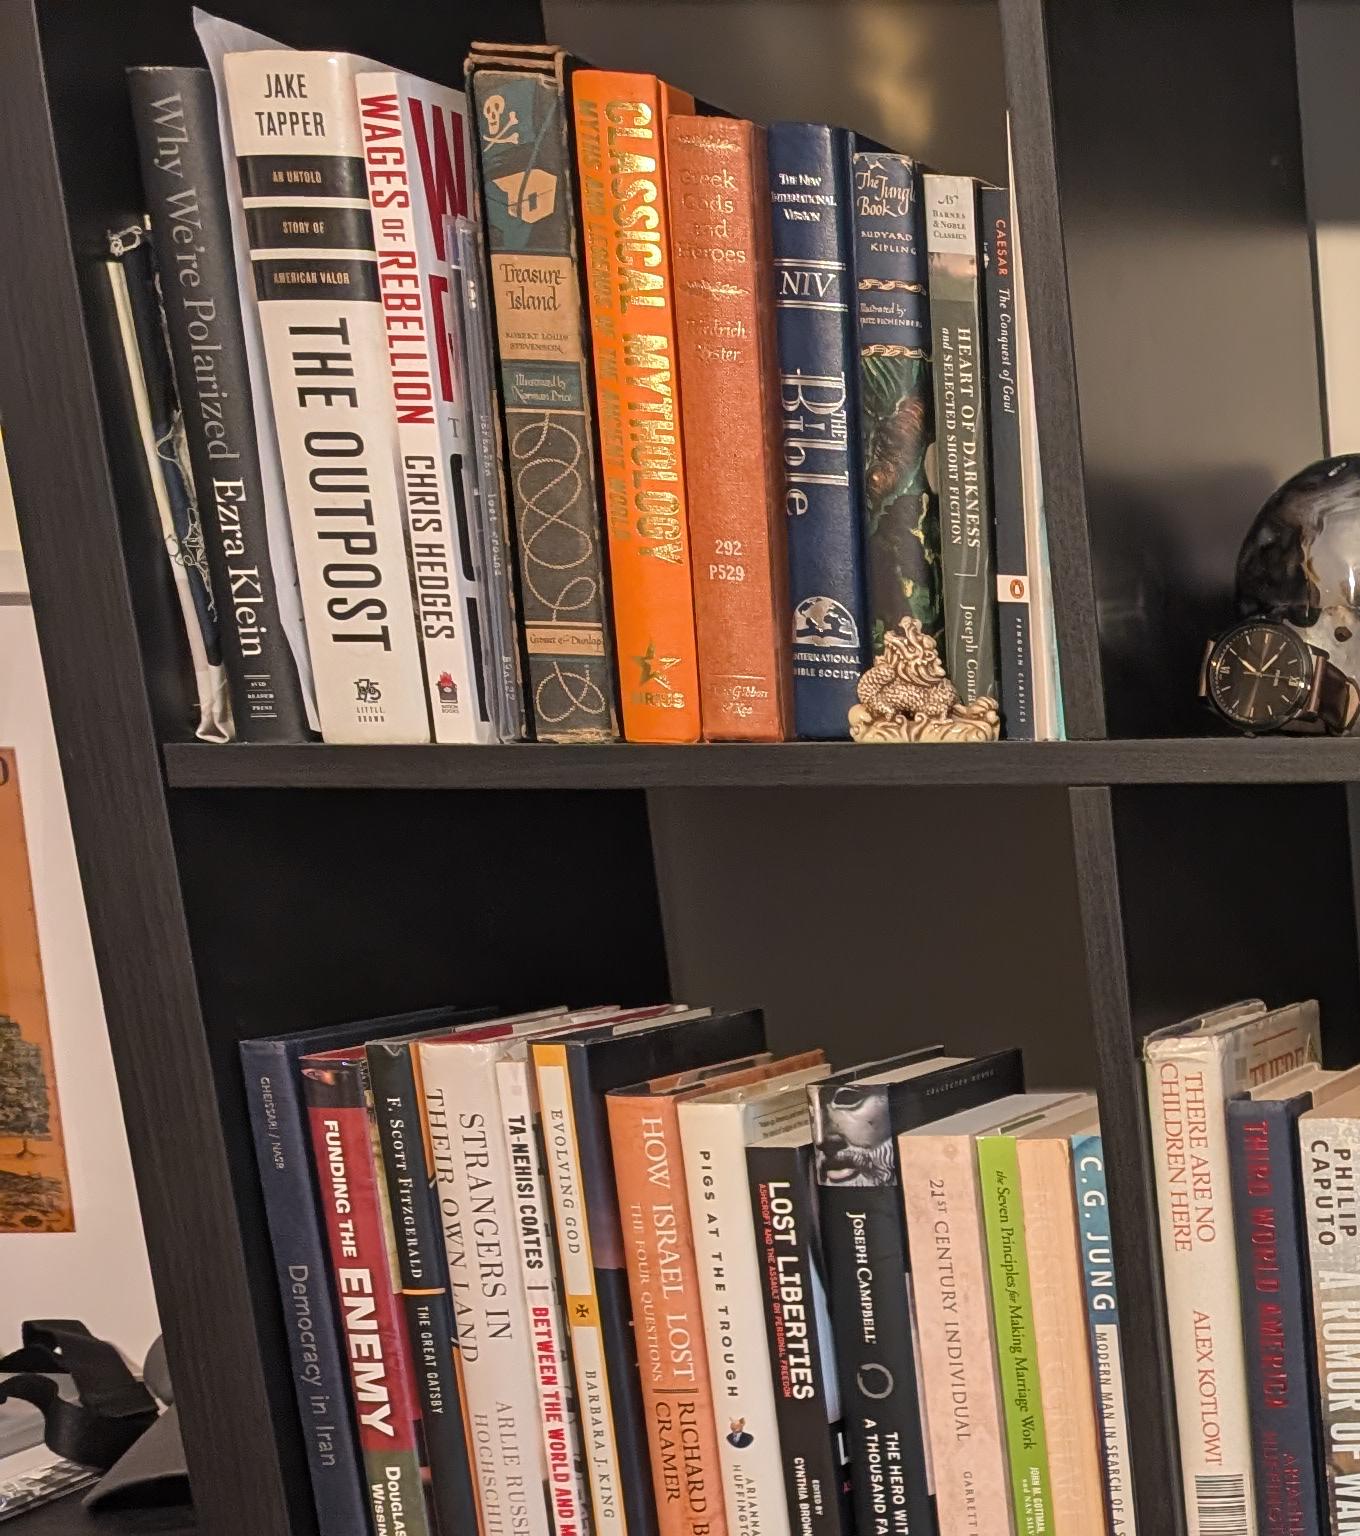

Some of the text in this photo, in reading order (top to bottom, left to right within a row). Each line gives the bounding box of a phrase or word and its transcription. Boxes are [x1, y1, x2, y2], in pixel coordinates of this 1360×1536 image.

[264, 73, 308, 99] JAKE
[255, 111, 326, 138] TAPPER
[359, 93, 435, 425] WAGES OF REBELLION
[500, 262, 566, 285] Treasure
[780, 271, 836, 298] NIV
[507, 286, 561, 312] Island
[604, 101, 685, 566] CLASSICAL MYTHOLOGY
[288, 318, 391, 652] THE OUTPOST
[716, 540, 742, 556] 292
[211, 478, 263, 658] Ezra Klein
[709, 565, 745, 582] P529
[324, 1119, 394, 1437] FUNDING THE ENEMY
[1318, 1270, 1346, 1289] A
